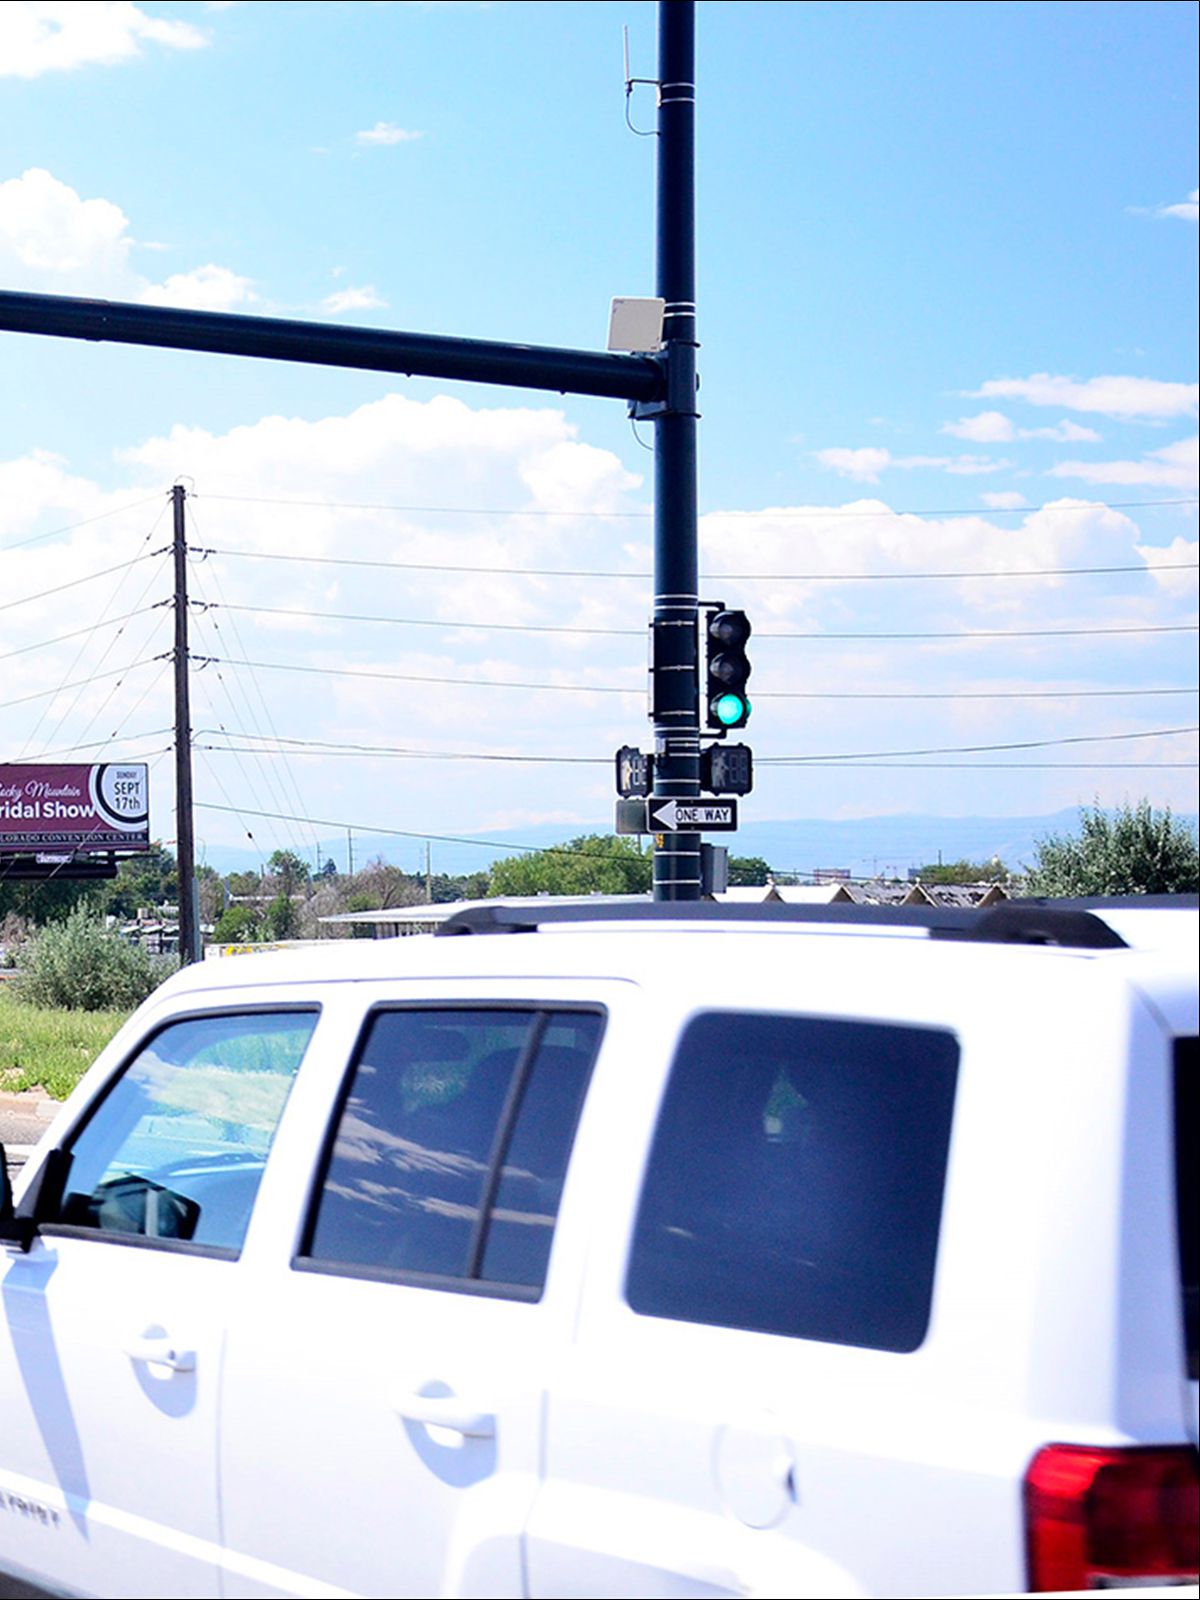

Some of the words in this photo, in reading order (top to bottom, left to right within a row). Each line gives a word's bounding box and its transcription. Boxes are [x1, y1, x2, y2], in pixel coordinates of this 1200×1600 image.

[24, 780, 81, 798] Mountain
[114, 781, 140, 795] SEPT
[42, 801, 96, 818] Show
[115, 797, 141, 810] 17th
[675, 808, 698, 822] ONE
[704, 809, 729, 821] WAY
[42, 834, 104, 842] CONVENTION
